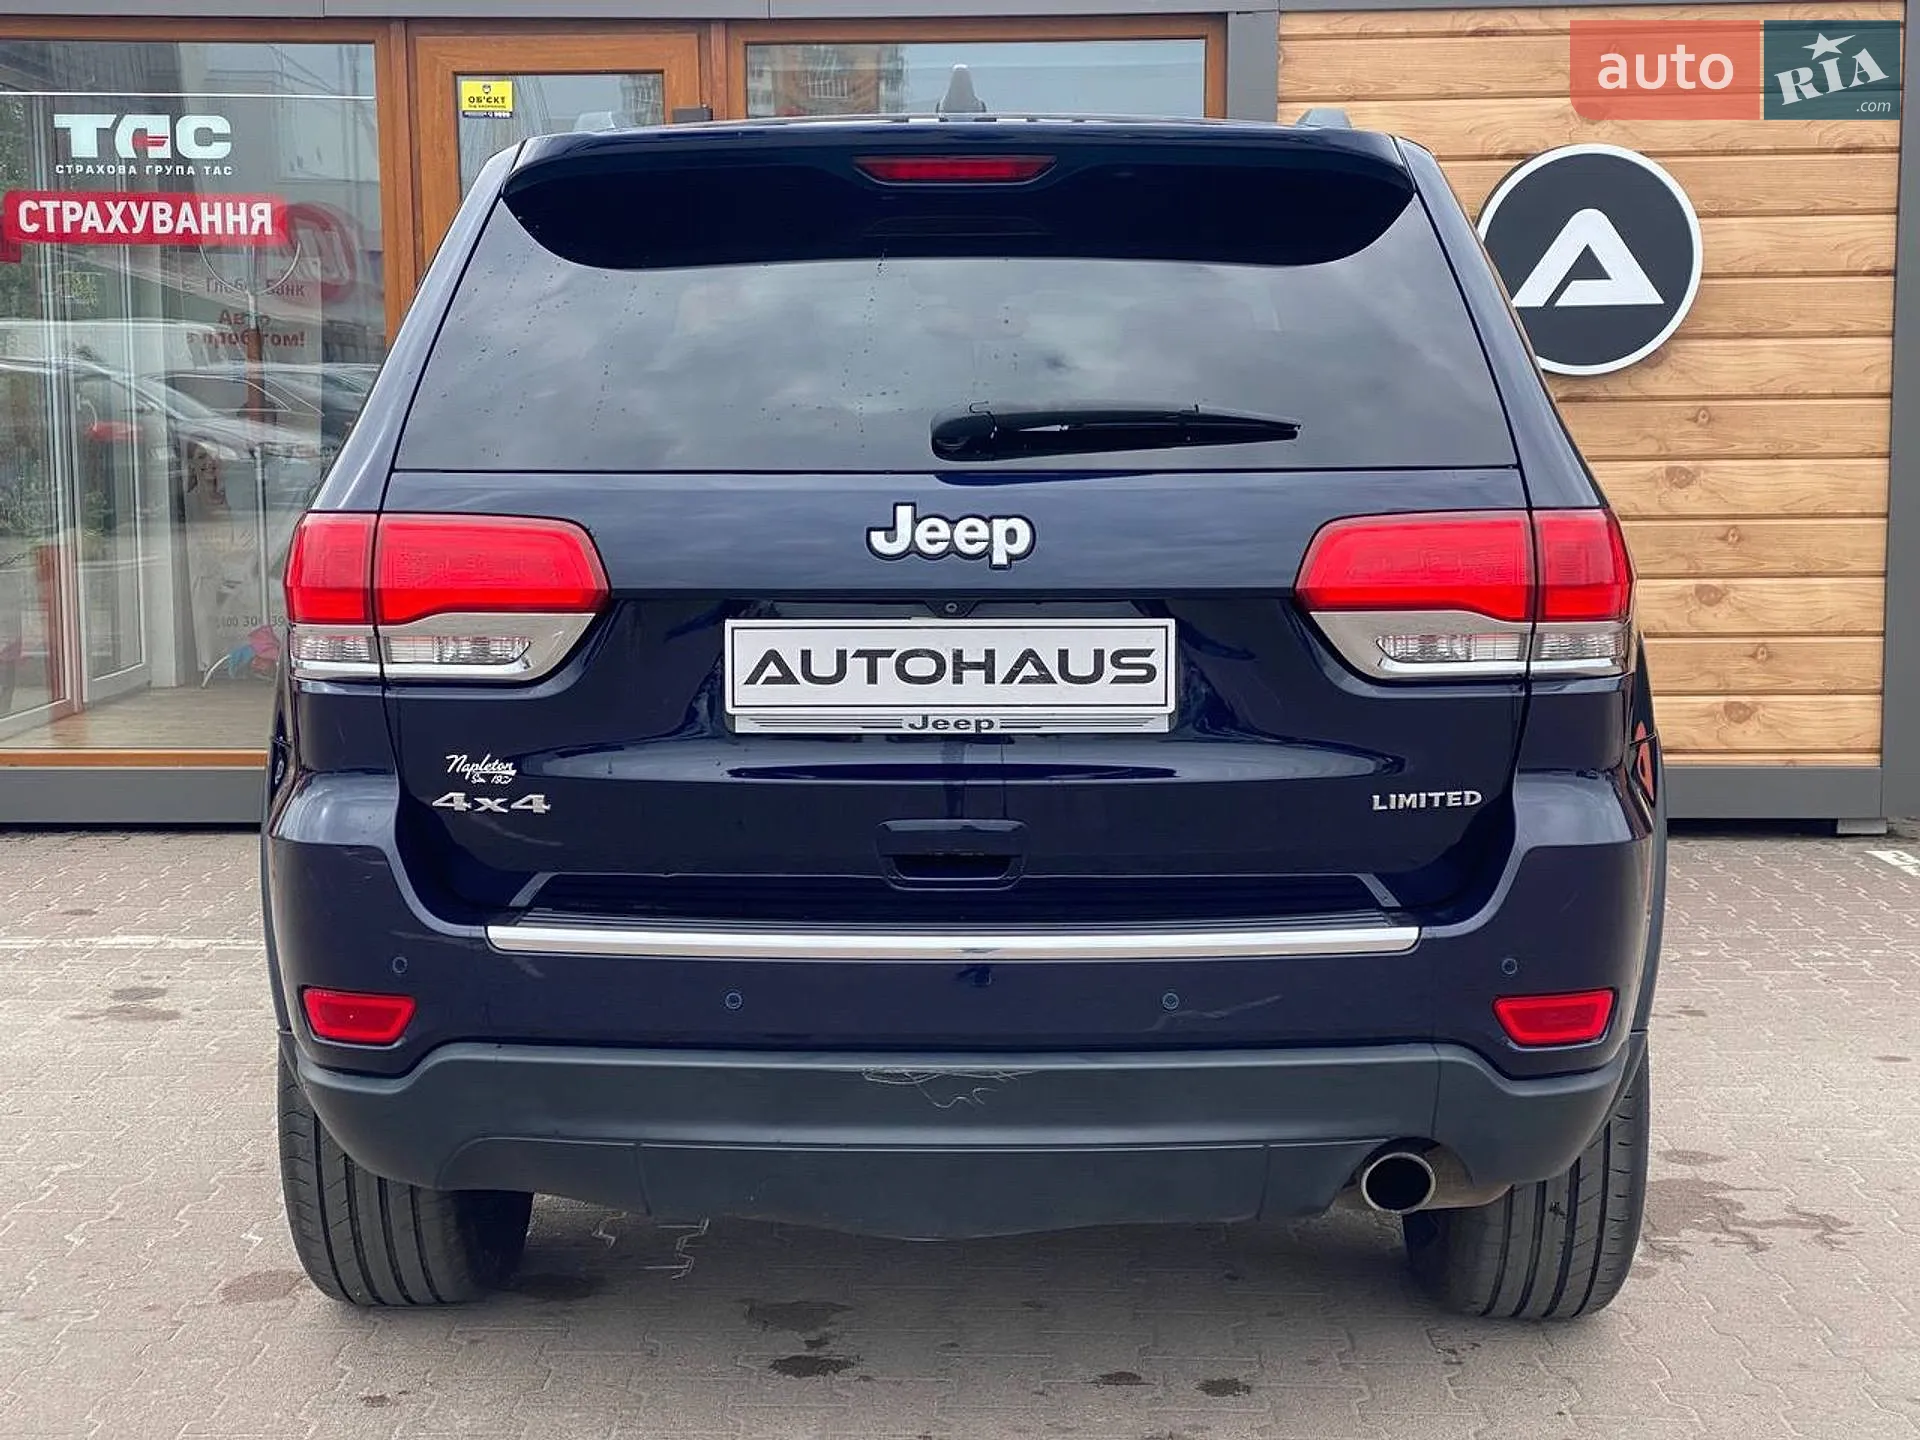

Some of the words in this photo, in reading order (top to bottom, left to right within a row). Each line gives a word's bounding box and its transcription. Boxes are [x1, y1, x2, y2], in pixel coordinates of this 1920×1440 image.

[54, 114, 232, 159] ТАС
[55, 164, 138, 176] СТРАХОВА
[146, 165, 196, 176] ГРУПА
[203, 166, 233, 177] ТАС
[18, 199, 273, 236] СТРАХУВАННЯ
[867, 502, 1036, 570] Jeep
[743, 648, 1158, 686] AUTOHAUS
[907, 715, 995, 734] Jeep
[445, 754, 516, 780] Napleton
[432, 792, 551, 814] 4x4
[1372, 790, 1482, 811] LIMITED
